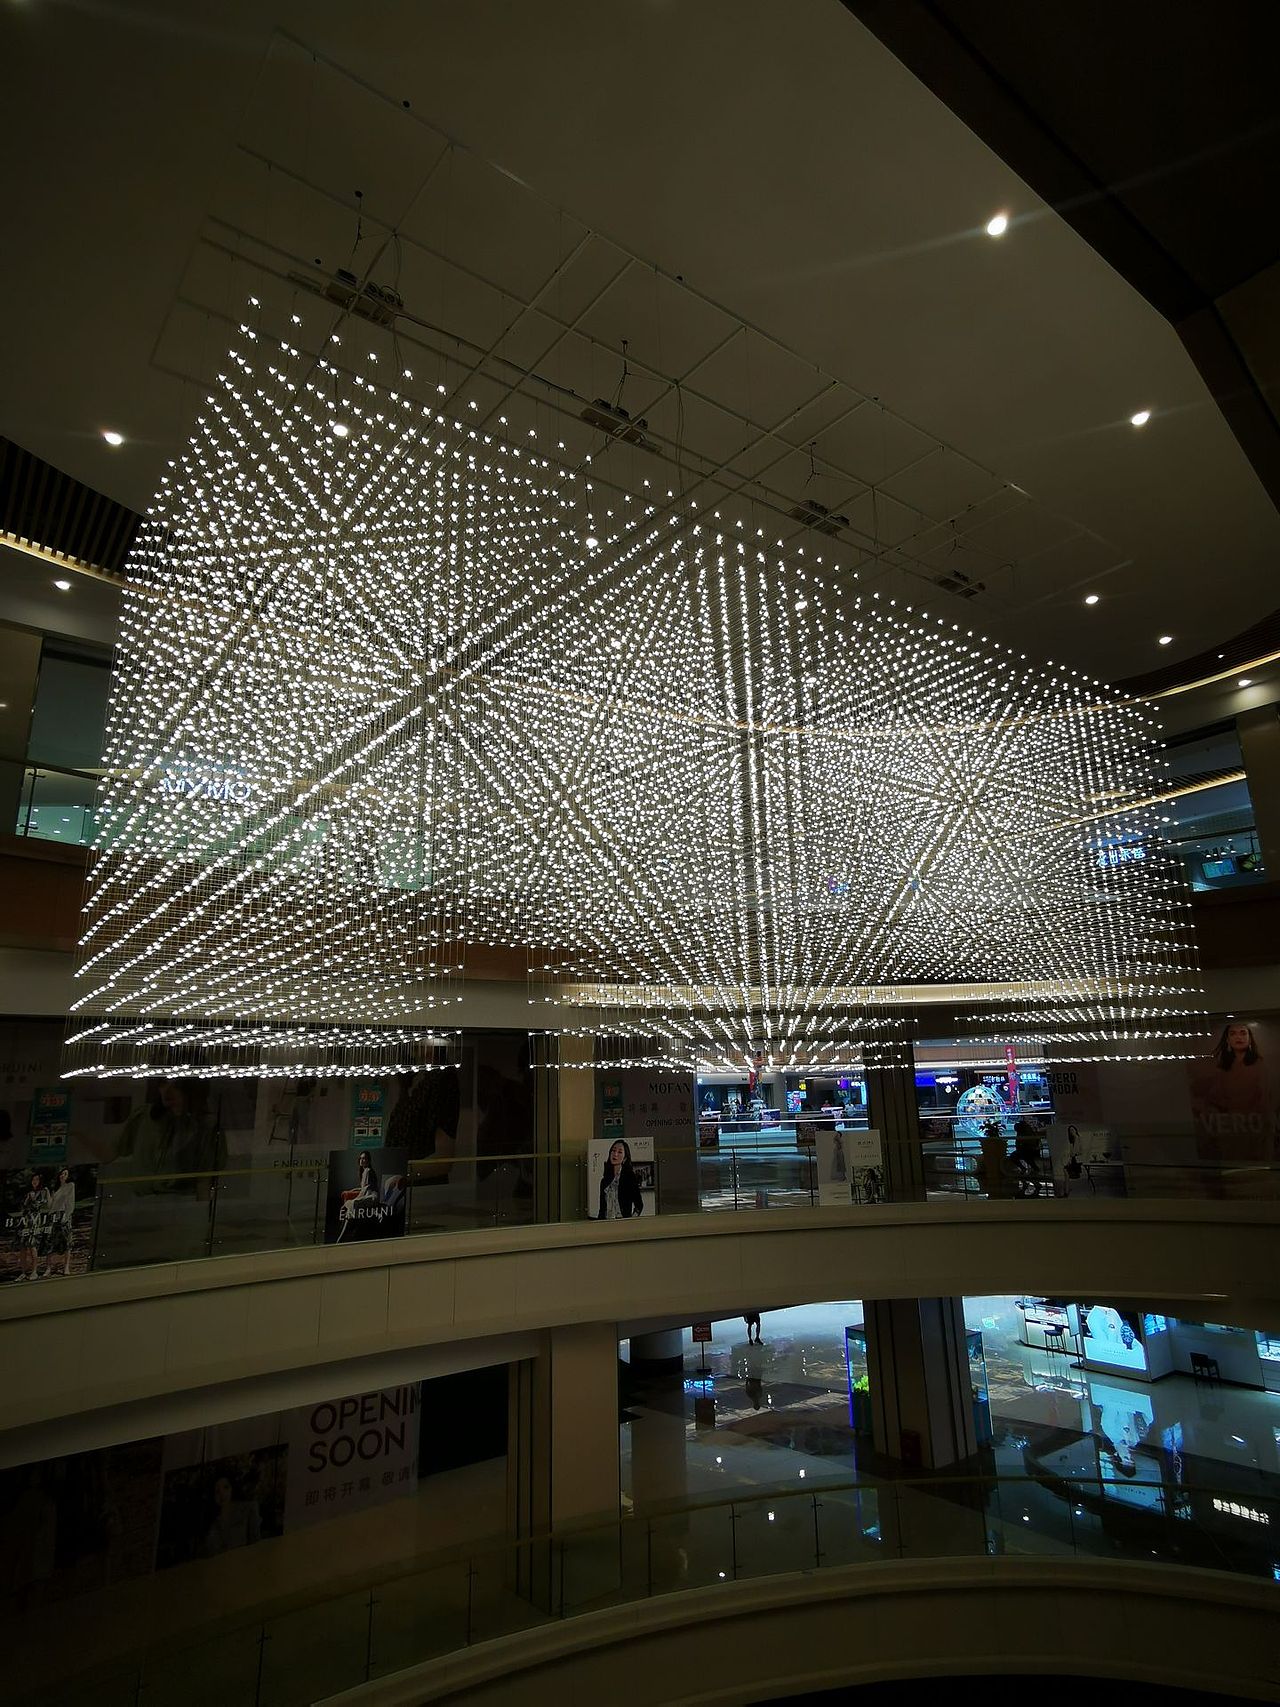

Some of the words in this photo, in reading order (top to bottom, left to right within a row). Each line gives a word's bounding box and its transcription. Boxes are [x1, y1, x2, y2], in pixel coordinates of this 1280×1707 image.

[1200, 1112, 1264, 1134] VERO
[339, 1206, 393, 1221] ENRUINI
[307, 1421, 405, 1472] SOON
